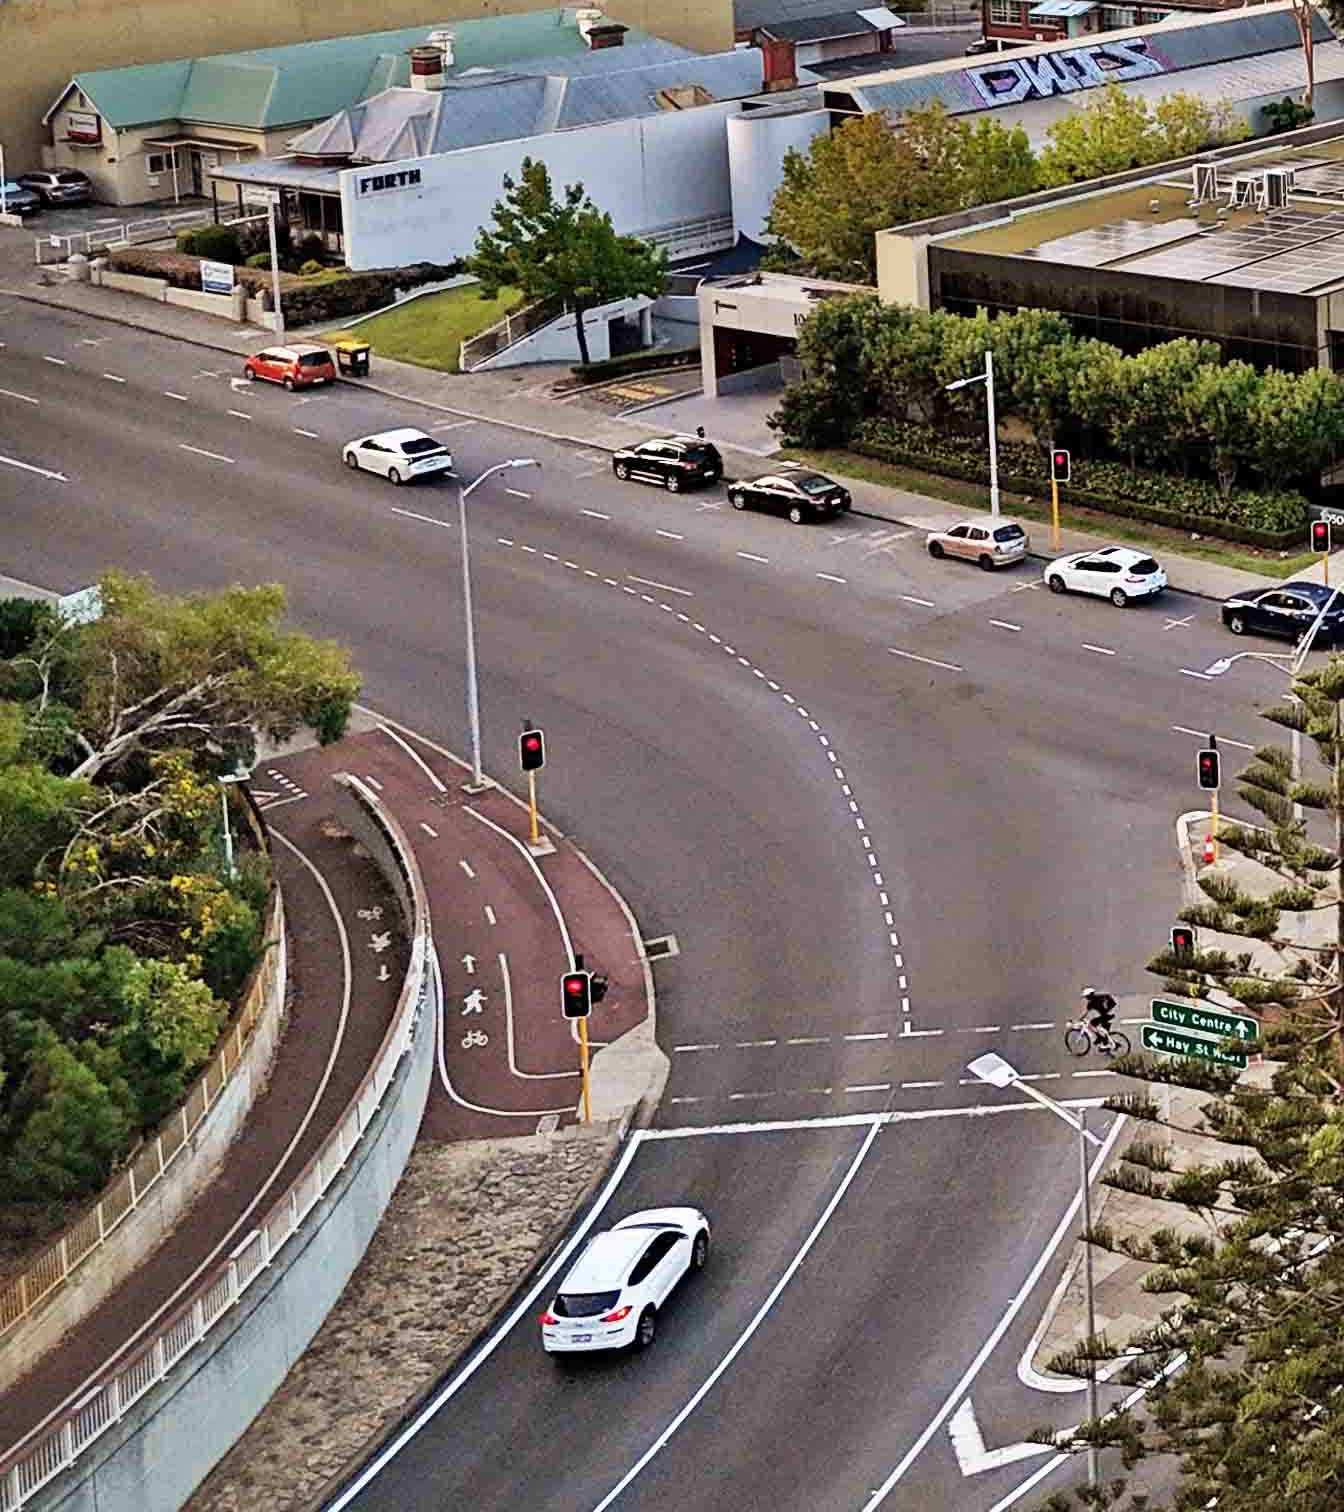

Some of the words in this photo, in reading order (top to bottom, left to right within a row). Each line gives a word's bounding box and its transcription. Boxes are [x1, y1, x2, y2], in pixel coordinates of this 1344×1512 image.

[360, 168, 421, 194] FORTH
[1160, 1007, 1185, 1024] City
[1191, 1014, 1232, 1031] Centre
[1166, 1036, 1190, 1053] Hay
[1195, 1043, 1209, 1056] St
